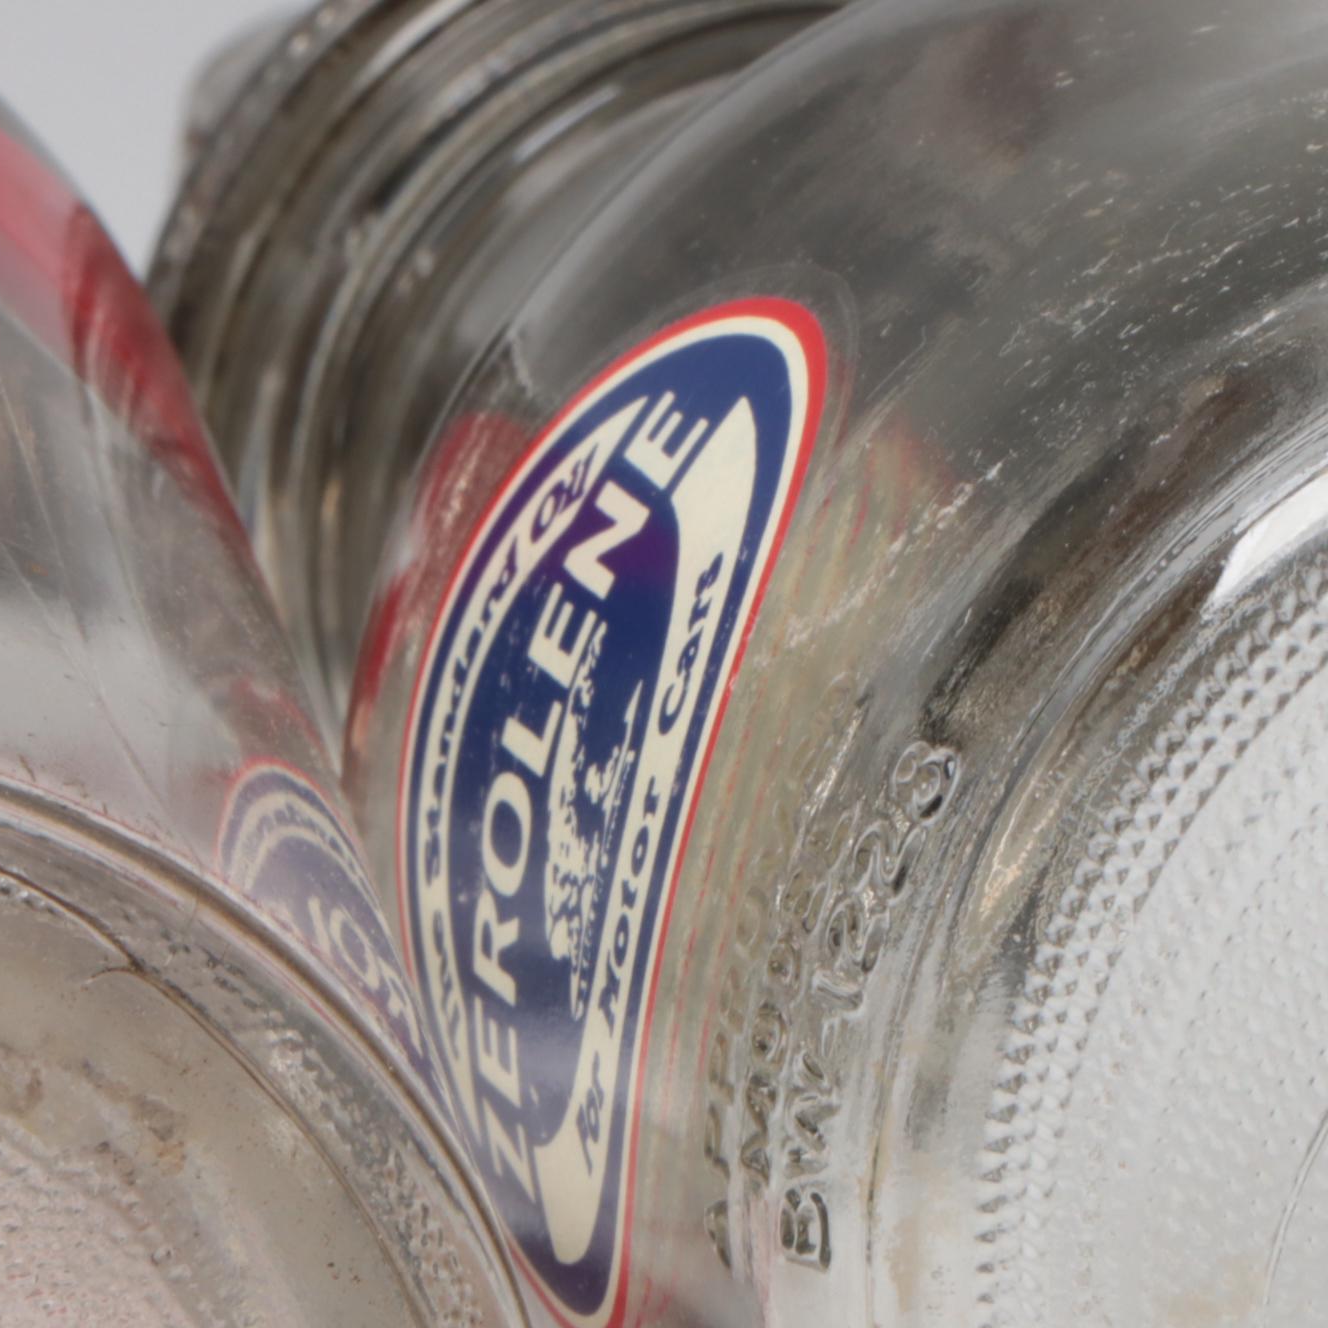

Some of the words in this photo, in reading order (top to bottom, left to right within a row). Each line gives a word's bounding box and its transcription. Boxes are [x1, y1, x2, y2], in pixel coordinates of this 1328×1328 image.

[424, 534, 523, 888] Standard
[530, 440, 601, 546] Oil
[472, 390, 710, 1203] ZEROLENE
[597, 776, 665, 1037] Motor
[658, 550, 725, 737] Cars
